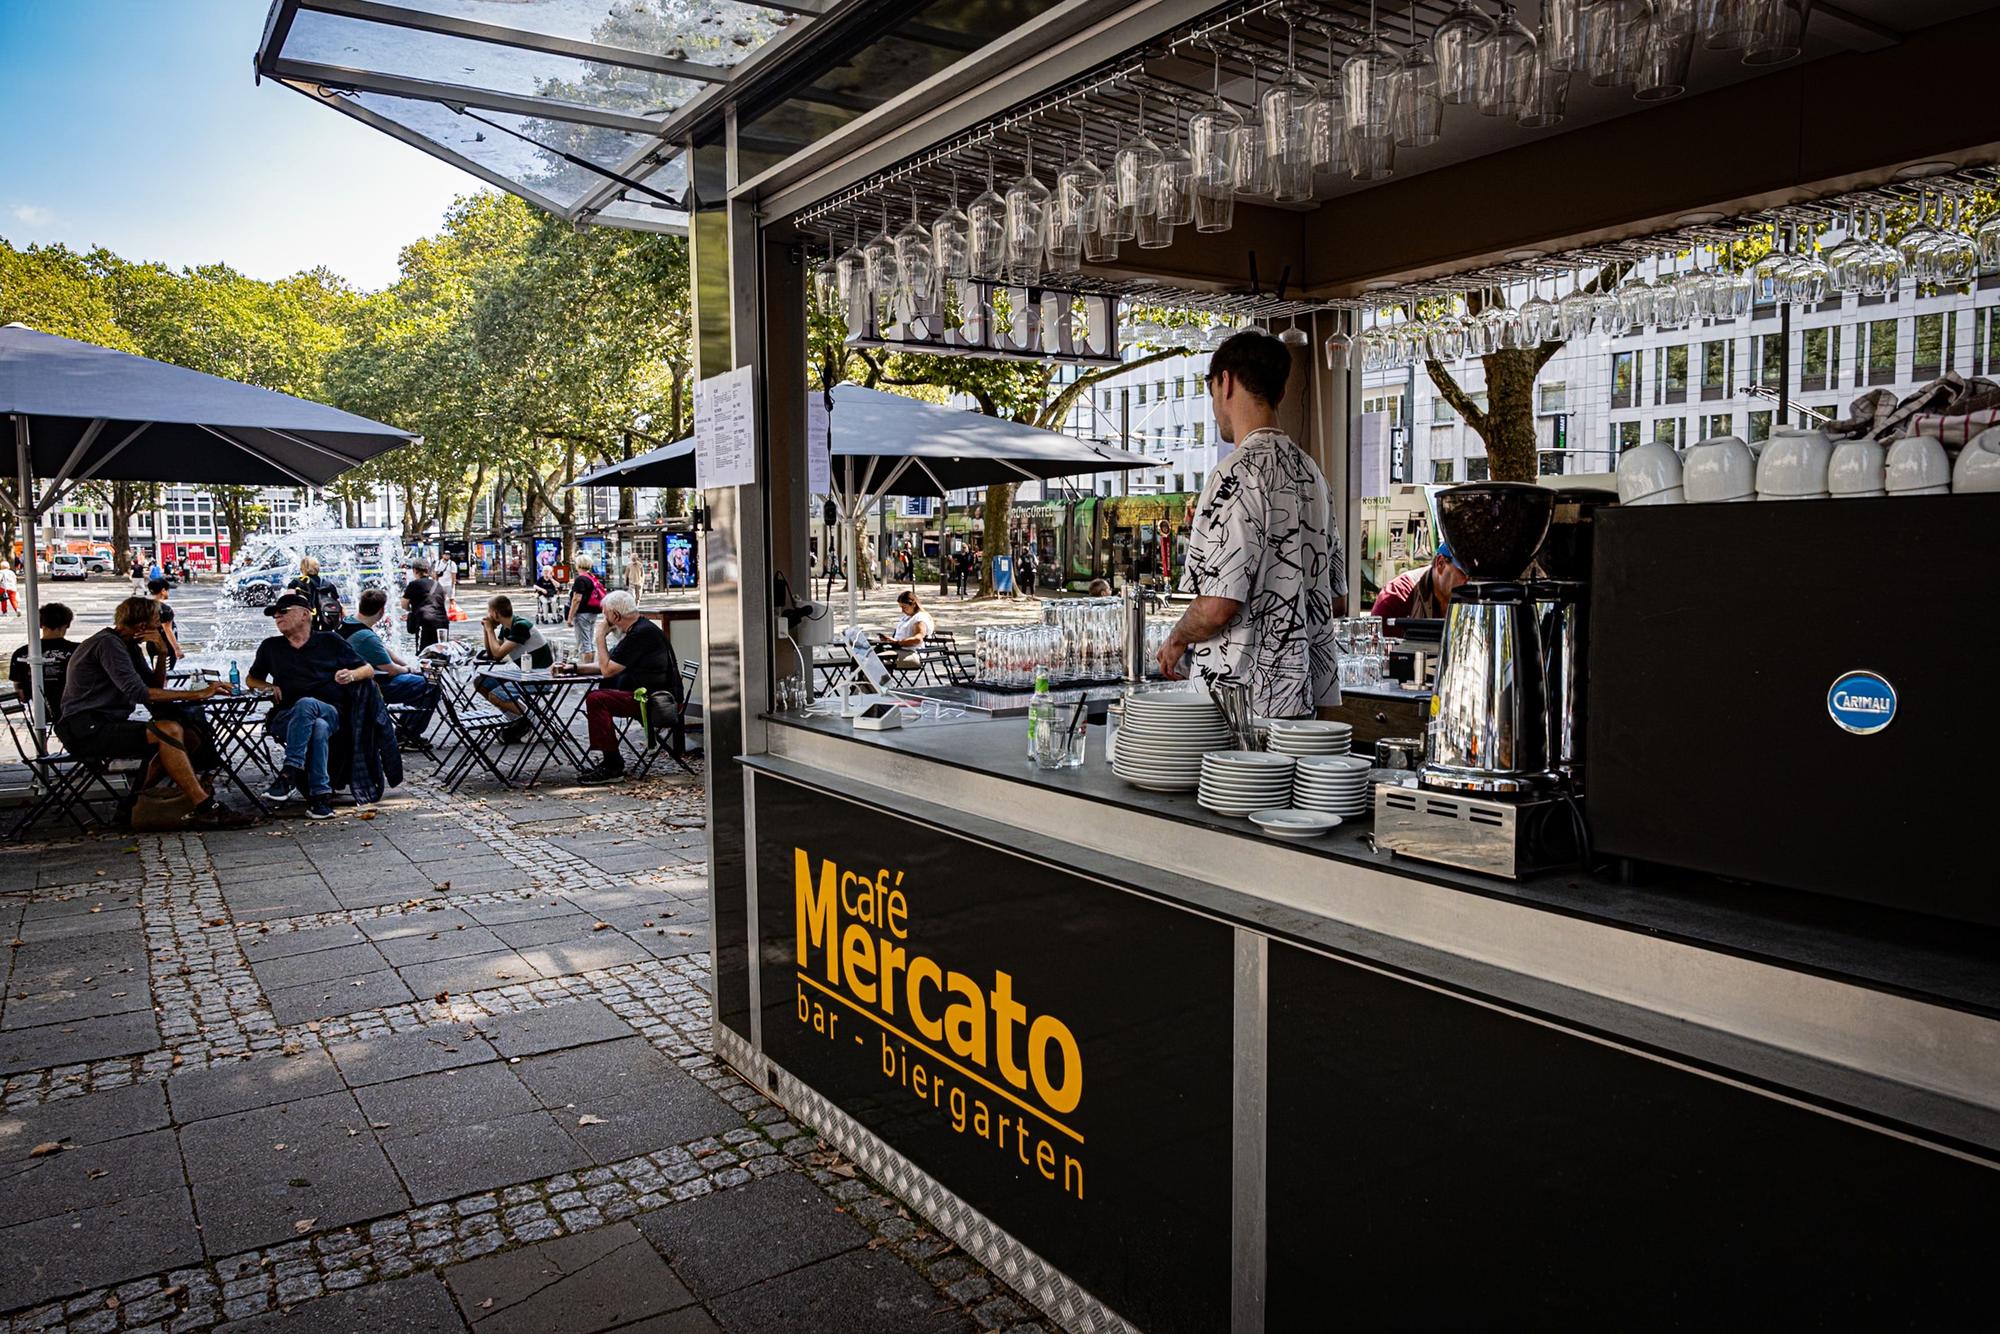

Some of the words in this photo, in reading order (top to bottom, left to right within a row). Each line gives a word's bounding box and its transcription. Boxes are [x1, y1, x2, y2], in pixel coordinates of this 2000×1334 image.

[1010, 504, 1054, 519] RÜNGÜRTEL
[1833, 690, 1891, 714] CARIMALI
[841, 870, 909, 940] café
[794, 847, 1083, 1114] Mercato
[797, 982, 839, 1041] bar
[882, 1031, 1085, 1201] biergarten
